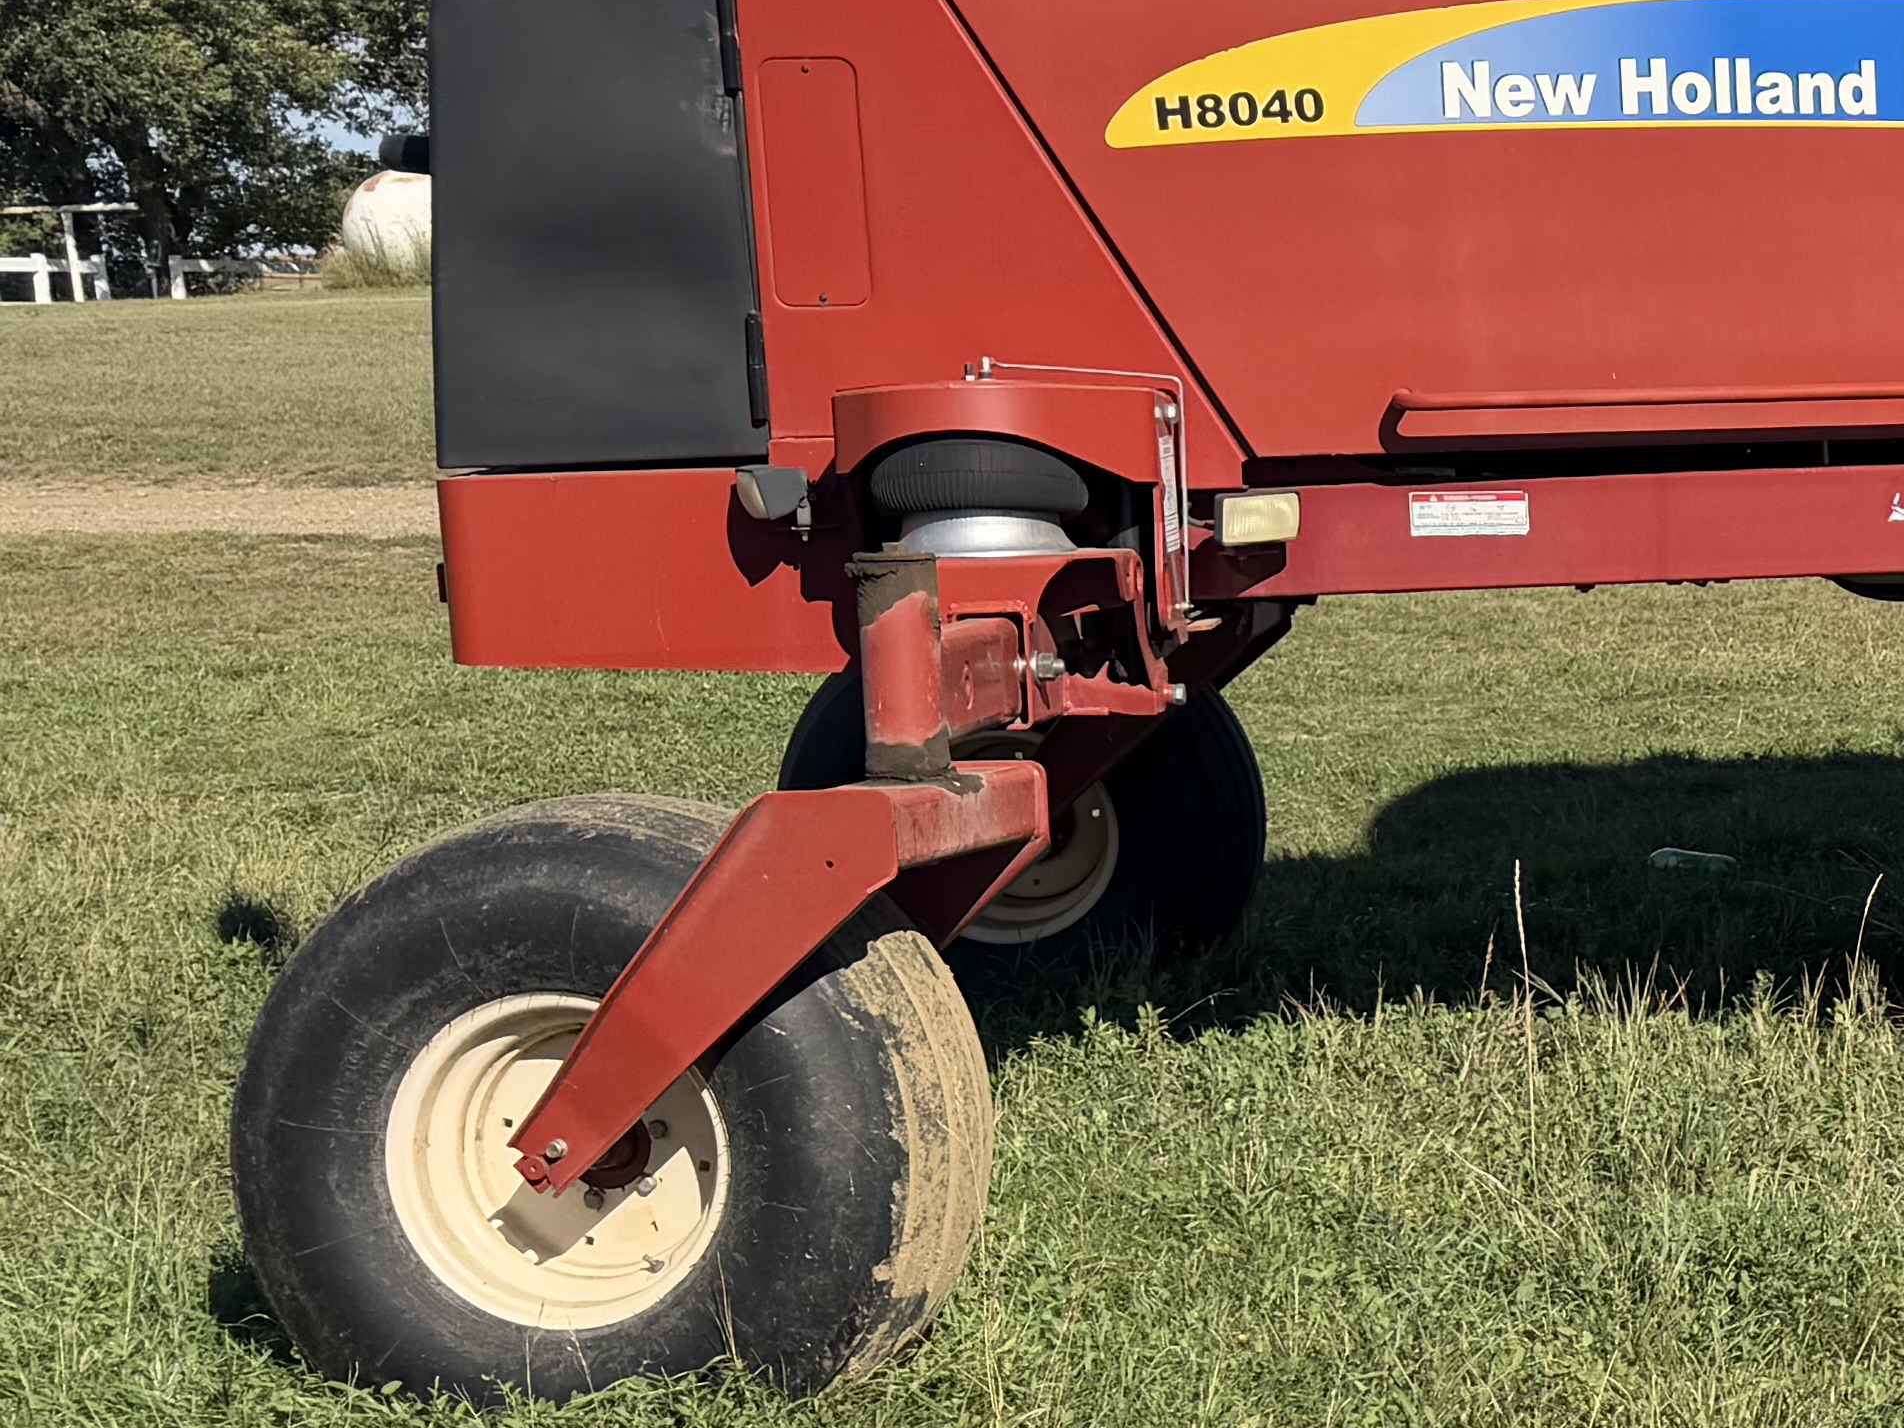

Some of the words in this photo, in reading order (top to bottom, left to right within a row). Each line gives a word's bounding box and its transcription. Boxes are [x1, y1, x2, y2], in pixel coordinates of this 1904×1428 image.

[1154, 87, 1325, 131] H8040
[1440, 60, 1596, 120] New
[1619, 58, 1878, 118] Holland
